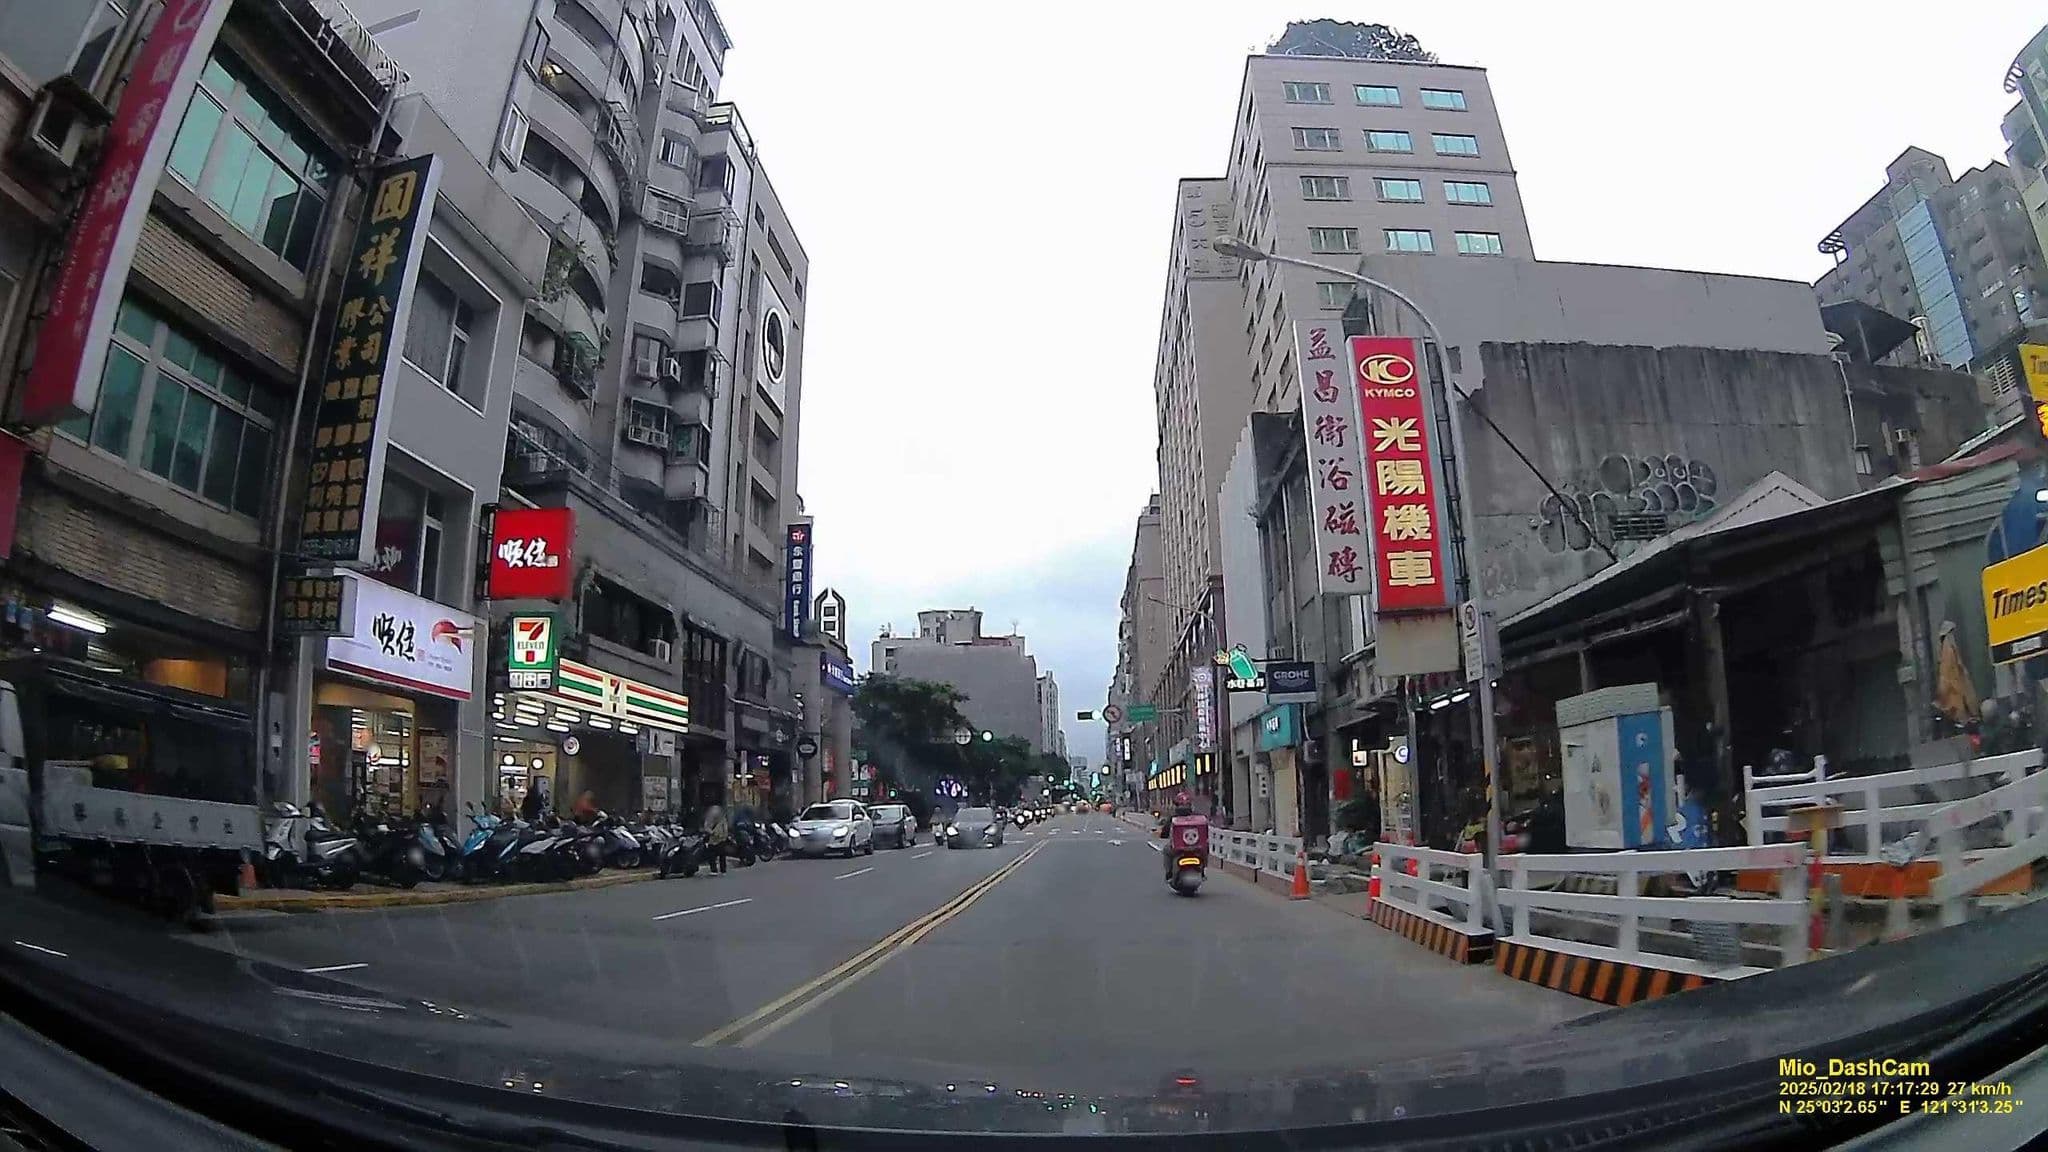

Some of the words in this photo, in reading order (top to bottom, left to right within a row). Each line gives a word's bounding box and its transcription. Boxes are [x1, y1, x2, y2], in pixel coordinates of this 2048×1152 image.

[1364, 389, 1415, 398] KYMCO
[1373, 416, 1435, 586] 光陽機車
[1993, 580, 2048, 619] Times
[1273, 669, 1310, 680] GROHE
